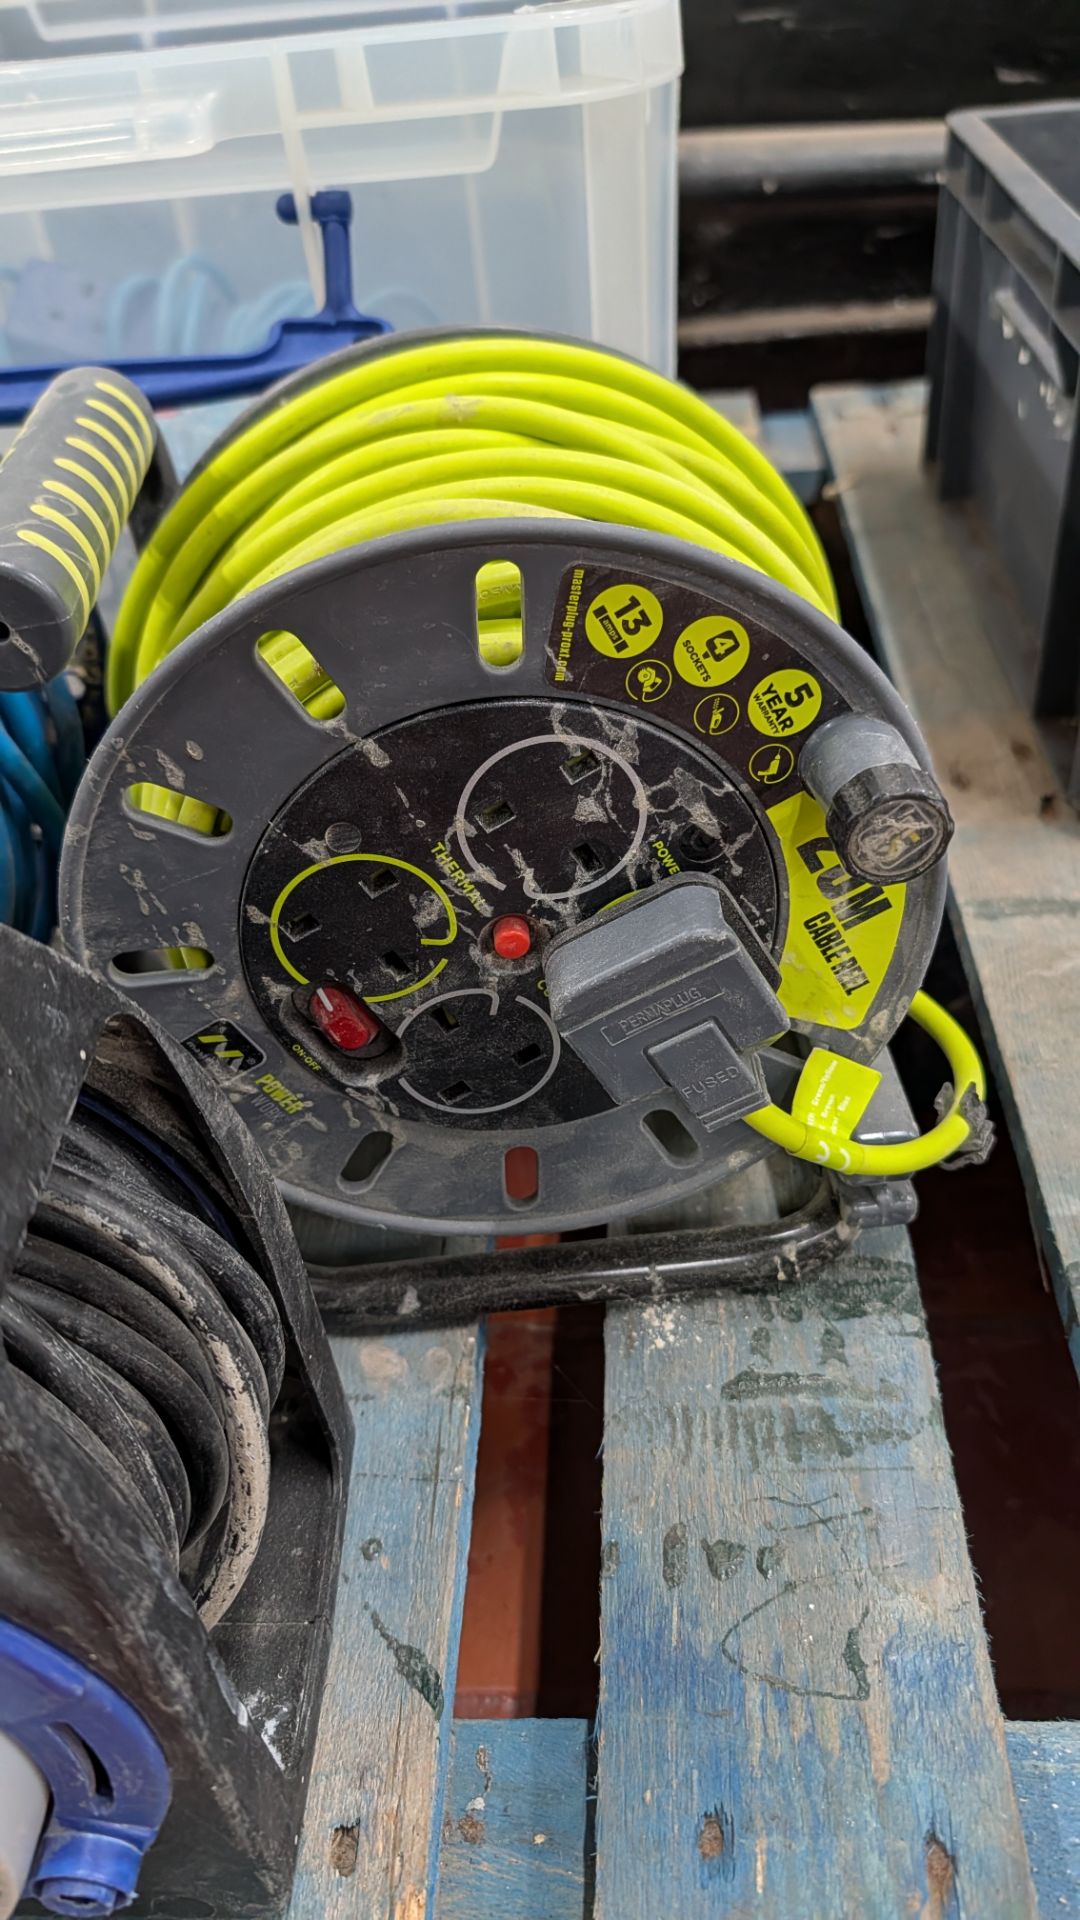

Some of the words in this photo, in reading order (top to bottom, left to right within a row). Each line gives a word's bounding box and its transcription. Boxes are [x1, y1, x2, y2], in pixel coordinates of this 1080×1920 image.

[602, 617, 620, 642] amps
[614, 595, 652, 637] 13
[682, 639, 712, 683] SOCKETS
[752, 692, 780, 735] WARRANTY
[761, 682, 794, 733] YEAR
[784, 682, 814, 708] 5
[430, 841, 486, 912] THERMAL
[803, 911, 852, 964] CABLE
[618, 987, 702, 1032] PERMAPLUG
[255, 1073, 304, 1115] POWER
[682, 1066, 740, 1098] FUSED
